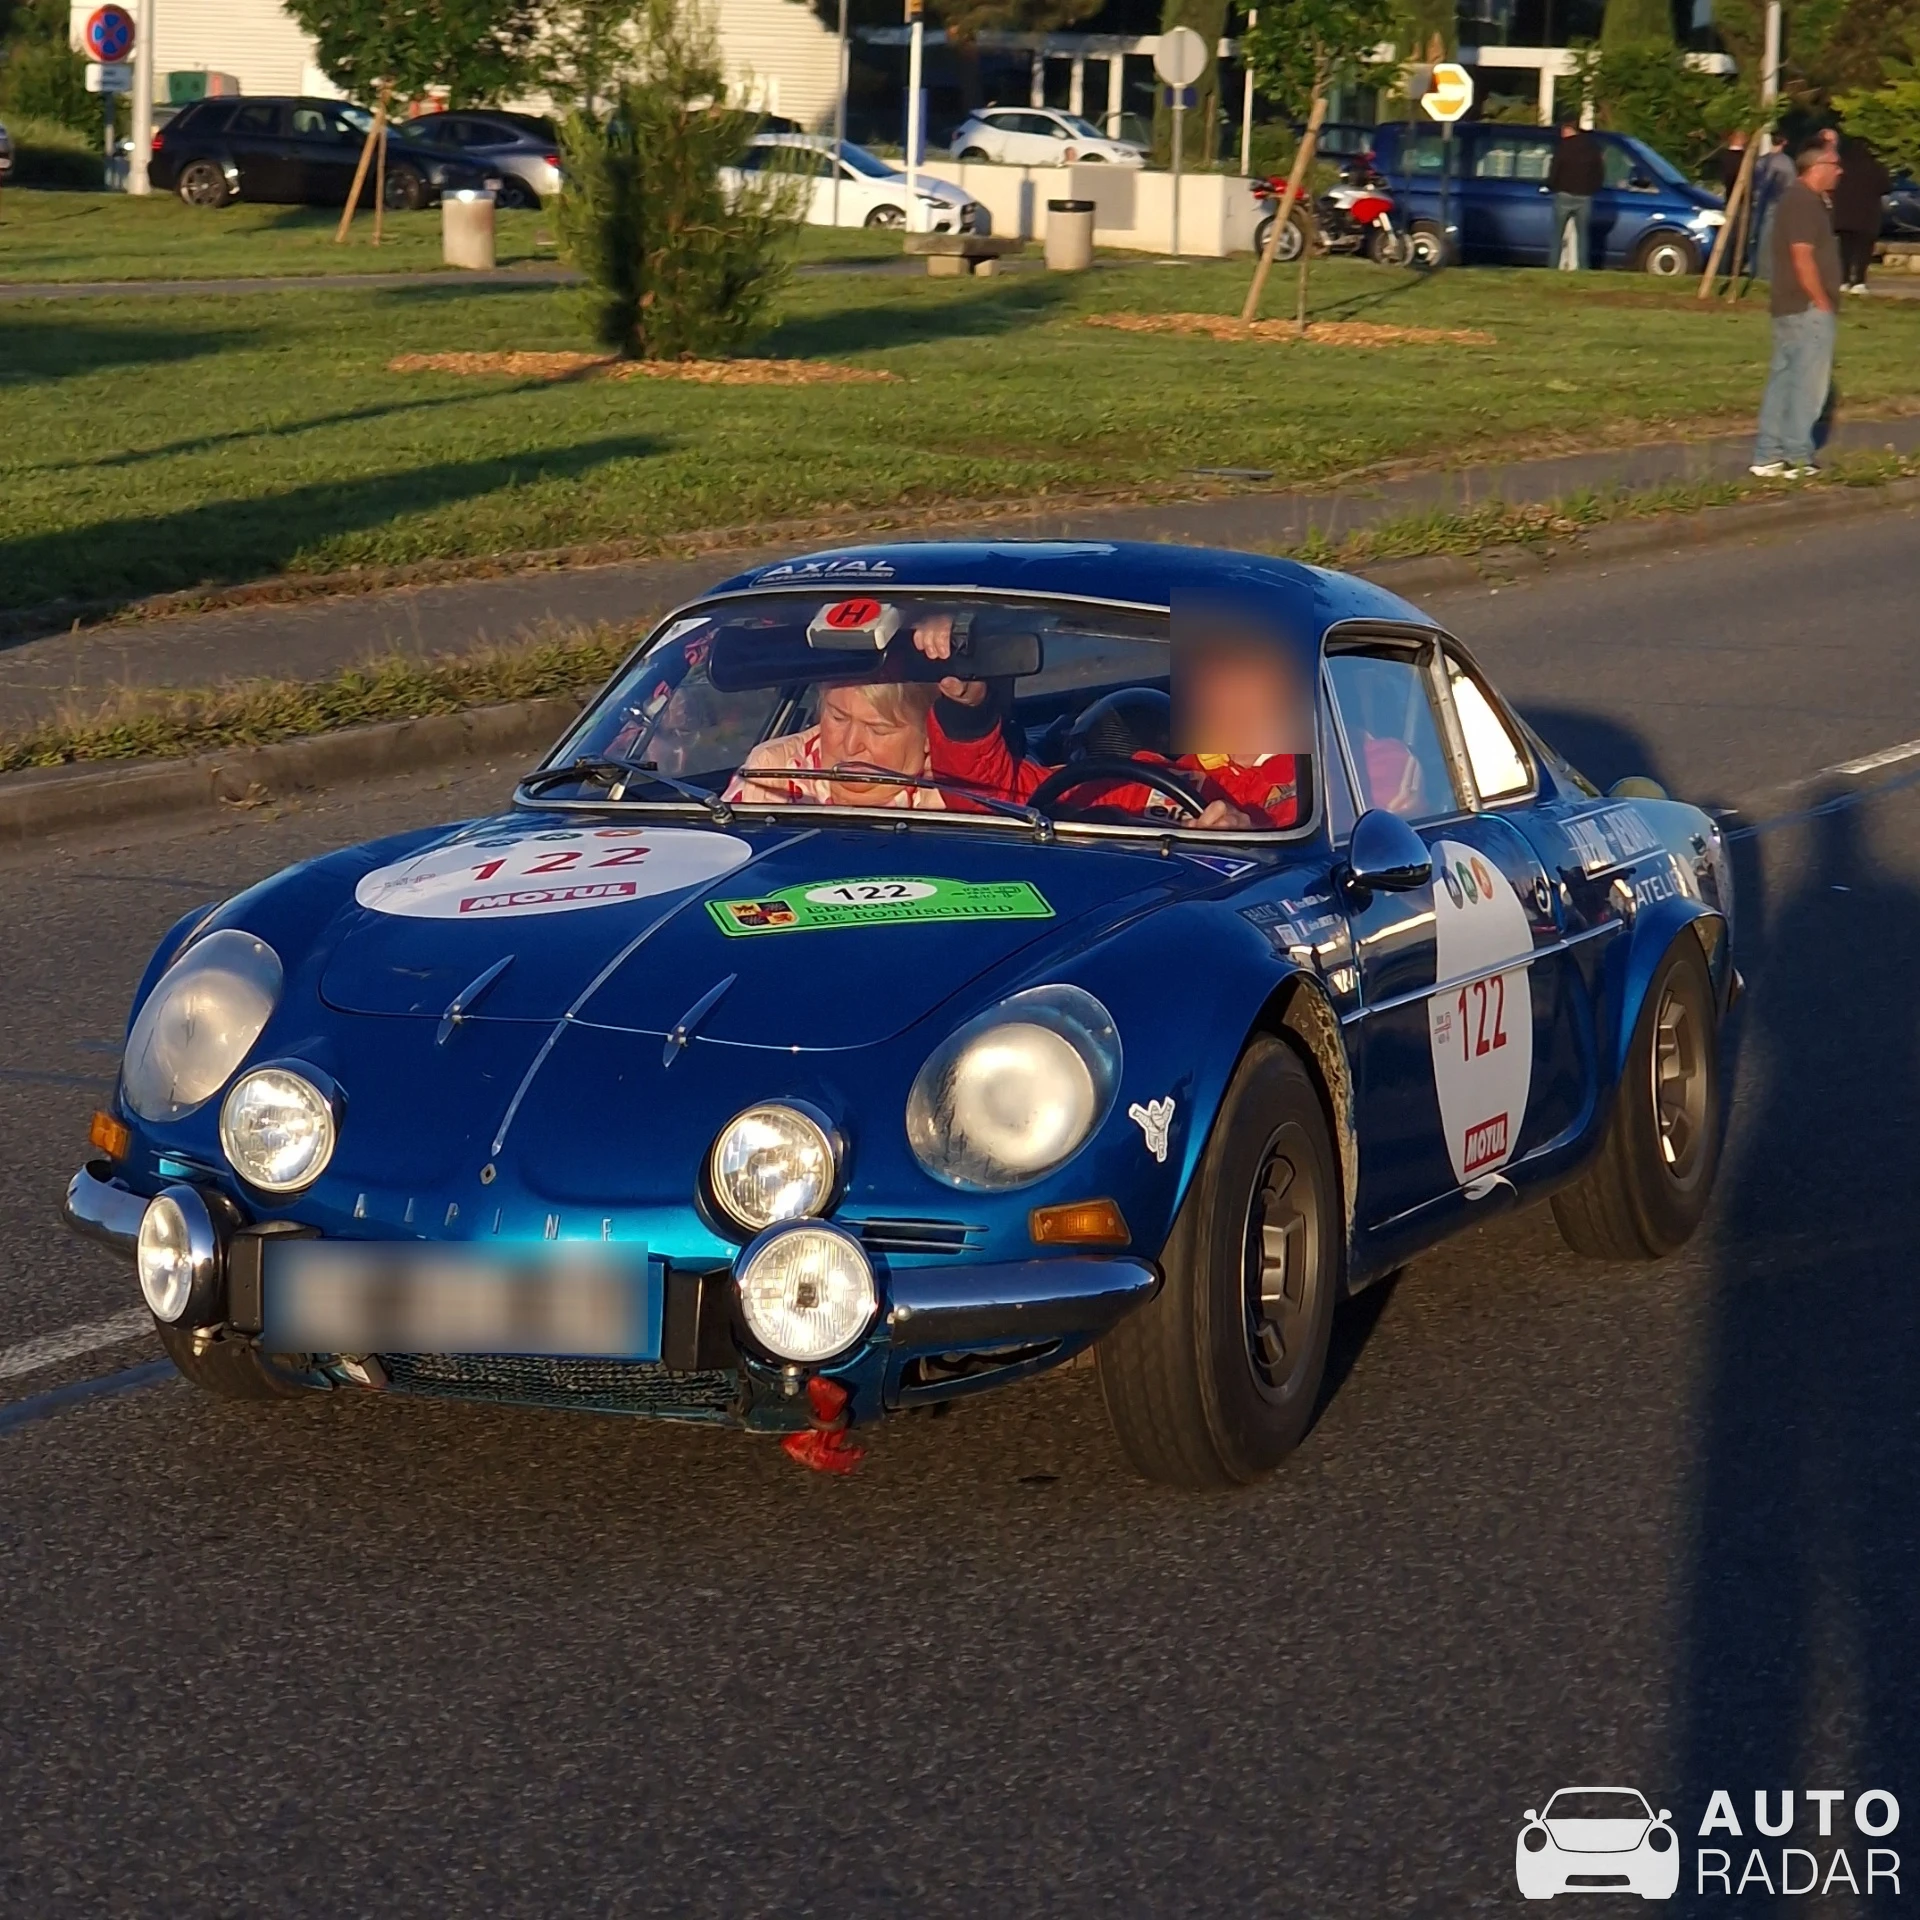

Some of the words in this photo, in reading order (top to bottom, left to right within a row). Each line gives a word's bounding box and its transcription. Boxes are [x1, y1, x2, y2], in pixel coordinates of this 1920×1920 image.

[762, 560, 896, 577] AXIAL
[835, 603, 872, 624] H
[471, 847, 652, 881] 122
[467, 884, 628, 910] MOTUL
[833, 884, 912, 901] 122
[805, 901, 915, 914] EDMOND
[811, 914, 846, 922] DE
[852, 905, 1014, 919] ROTHSCHILD
[1458, 974, 1507, 1062] 122
[1465, 1119, 1506, 1166] MOTUL
